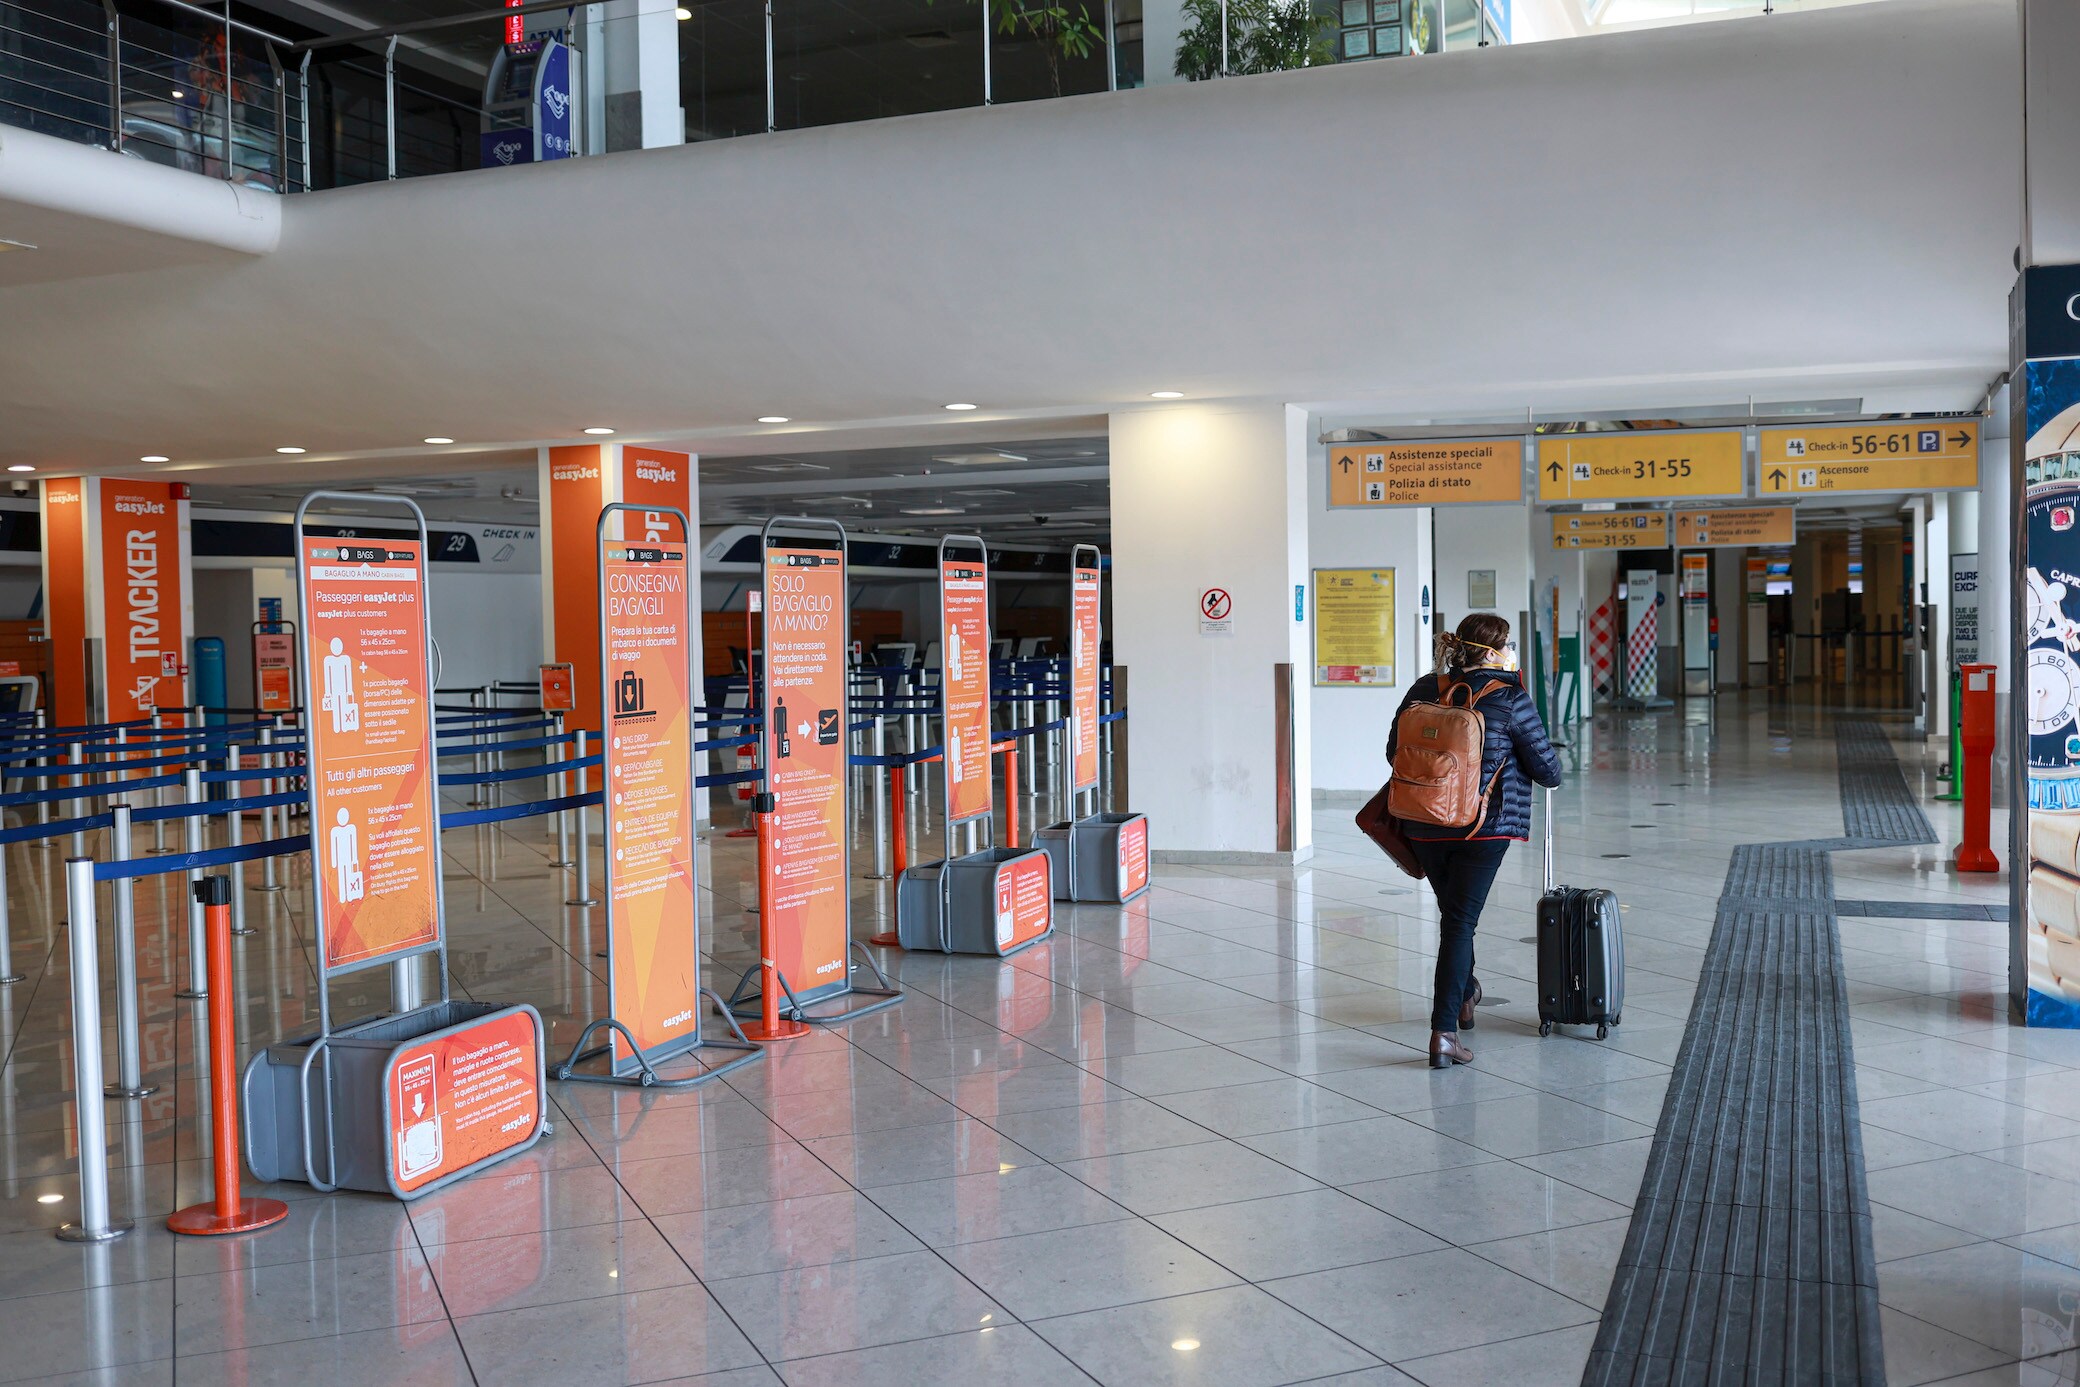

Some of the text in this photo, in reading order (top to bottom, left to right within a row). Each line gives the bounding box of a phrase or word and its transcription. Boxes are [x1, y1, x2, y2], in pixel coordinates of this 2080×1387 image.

[1808, 442, 1848, 452] Check-in
[1852, 434, 1910, 454] 56-61
[1390, 447, 1492, 460] Assistenze speciali
[636, 459, 660, 468] generation
[1390, 460, 1482, 473] Special assistance
[1594, 459, 1691, 478] Check-in 31-55
[1820, 466, 1869, 474] Ascensore
[553, 467, 598, 480] easyJet
[636, 467, 676, 483] easyJet
[1390, 478, 1471, 488] Polizia di stato
[1820, 479, 1833, 488] Lift
[48, 493, 80, 504] easyJet
[1390, 492, 1419, 500] Police
[115, 500, 165, 516] easyJet
[1604, 517, 1636, 528] 56-61
[482, 528, 535, 540] CHECK IN
[1604, 535, 1636, 546] 31-55
[447, 536, 467, 552] 29
[357, 551, 374, 559] BAGS
[888, 546, 900, 559] 32
[609, 574, 681, 592] CONSEGNA
[773, 575, 805, 592] SOLO
[126, 530, 160, 664] TRACKER
[316, 591, 414, 604] Passeggeri easyJet plus
[773, 595, 832, 612] BAGAGLIO
[610, 597, 664, 616] BAGAGLI
[318, 610, 342, 619] easyJet
[344, 610, 356, 618] plus
[773, 615, 828, 631] A MANO?
[367, 628, 388, 638] bagaglio
[612, 626, 634, 636] Prepara
[642, 626, 652, 634] tua
[654, 625, 669, 634] carta
[612, 638, 636, 648] imbarco
[646, 636, 677, 646] documenti
[773, 642, 787, 651] Non
[793, 641, 826, 650] necessario
[619, 650, 641, 661] viaggio
[773, 654, 804, 662] attendere
[773, 664, 823, 674] Vai direttamente
[388, 678, 408, 686] bagaglio
[773, 677, 814, 688] alle partenze.
[345, 709, 355, 722] x1
[326, 761, 415, 782] Tutti gli altri passeggeri
[327, 783, 382, 797] All other customers
[374, 804, 395, 814] bagaglio
[369, 837, 413, 852] bagaglio potrebbe
[350, 878, 360, 892] x1
[816, 960, 842, 974] easyJet
[662, 1010, 692, 1028] easyJet
[457, 1055, 466, 1064] tuo
[466, 1046, 489, 1062] bagaglio
[403, 1064, 431, 1081] MAXIMUM
[453, 1065, 475, 1076] maniglie
[480, 1058, 494, 1066] ruote
[454, 1056, 523, 1088] deve entrare comodamente
[460, 1084, 478, 1096] questo
[479, 1073, 507, 1088] misuratore.
[454, 1100, 466, 1110] Non
[475, 1092, 490, 1102] alcun
[490, 1086, 504, 1096] limite
[501, 1113, 530, 1132] easyJet
